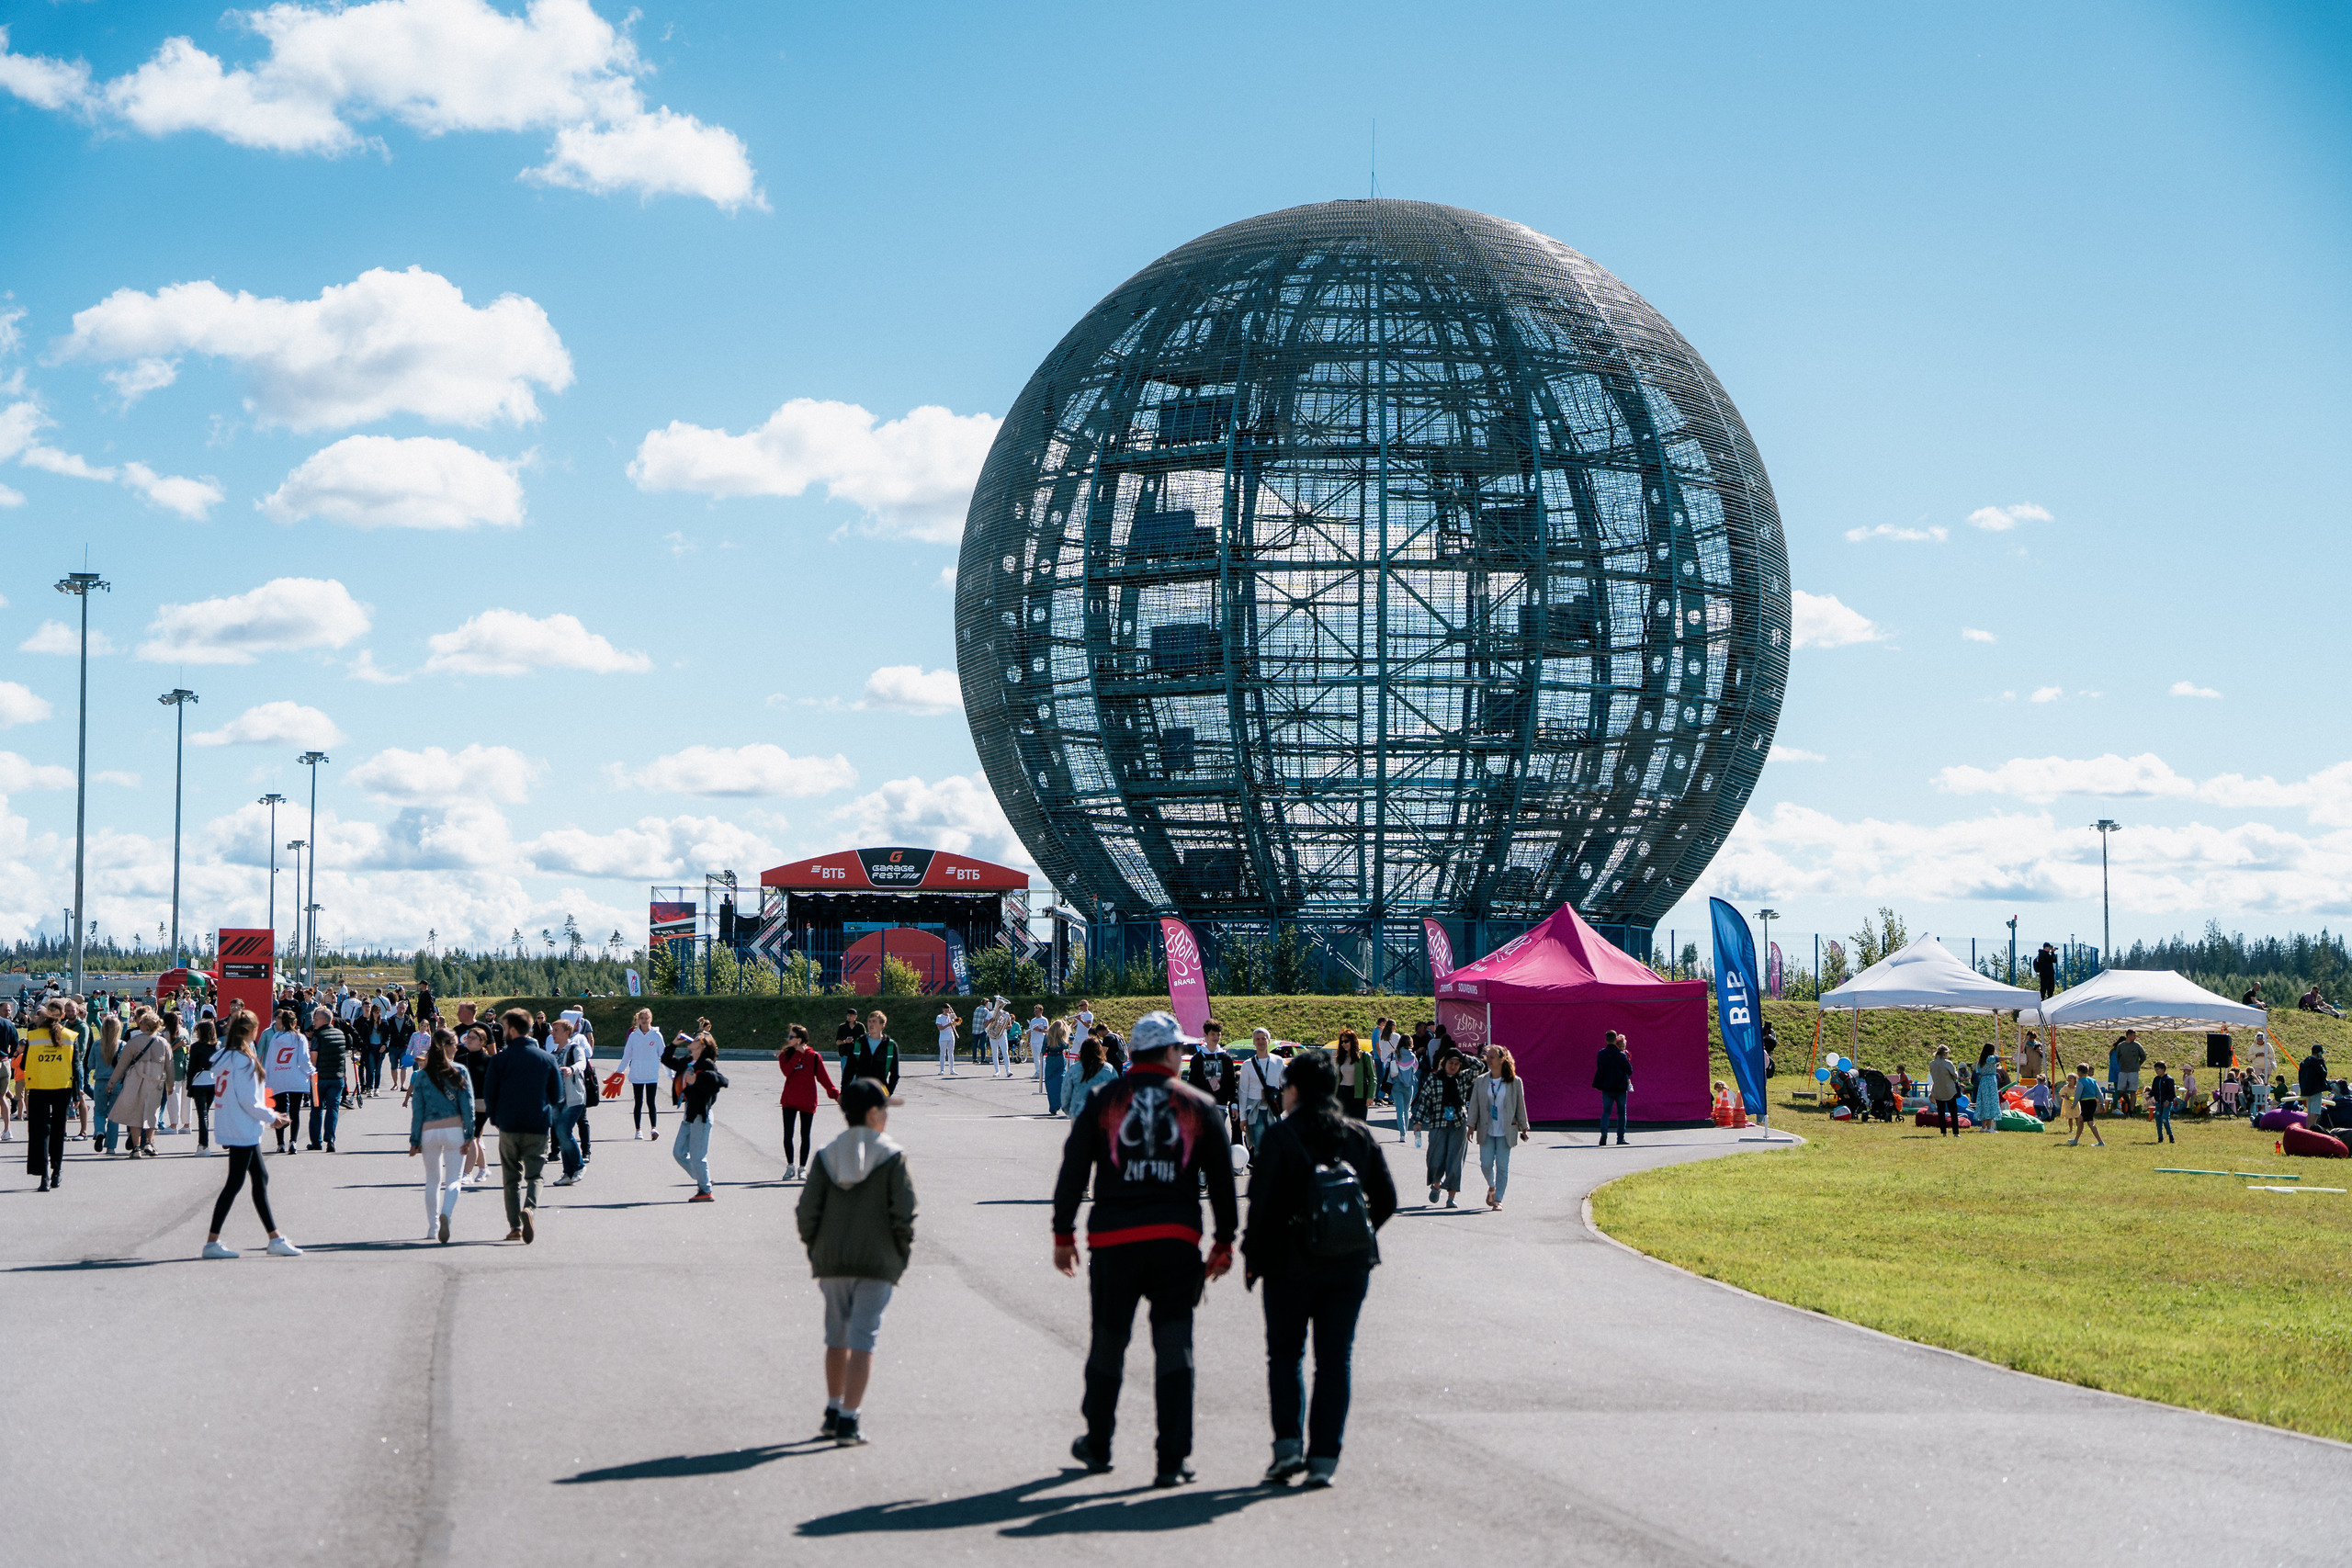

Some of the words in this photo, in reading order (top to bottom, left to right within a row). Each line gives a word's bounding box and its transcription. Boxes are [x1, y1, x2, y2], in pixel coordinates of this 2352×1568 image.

[822, 868, 845, 878] ВТБ
[957, 869, 980, 880] ВТБ
[1458, 983, 1478, 995] SOUVENIRS
[277, 1047, 296, 1065] G
